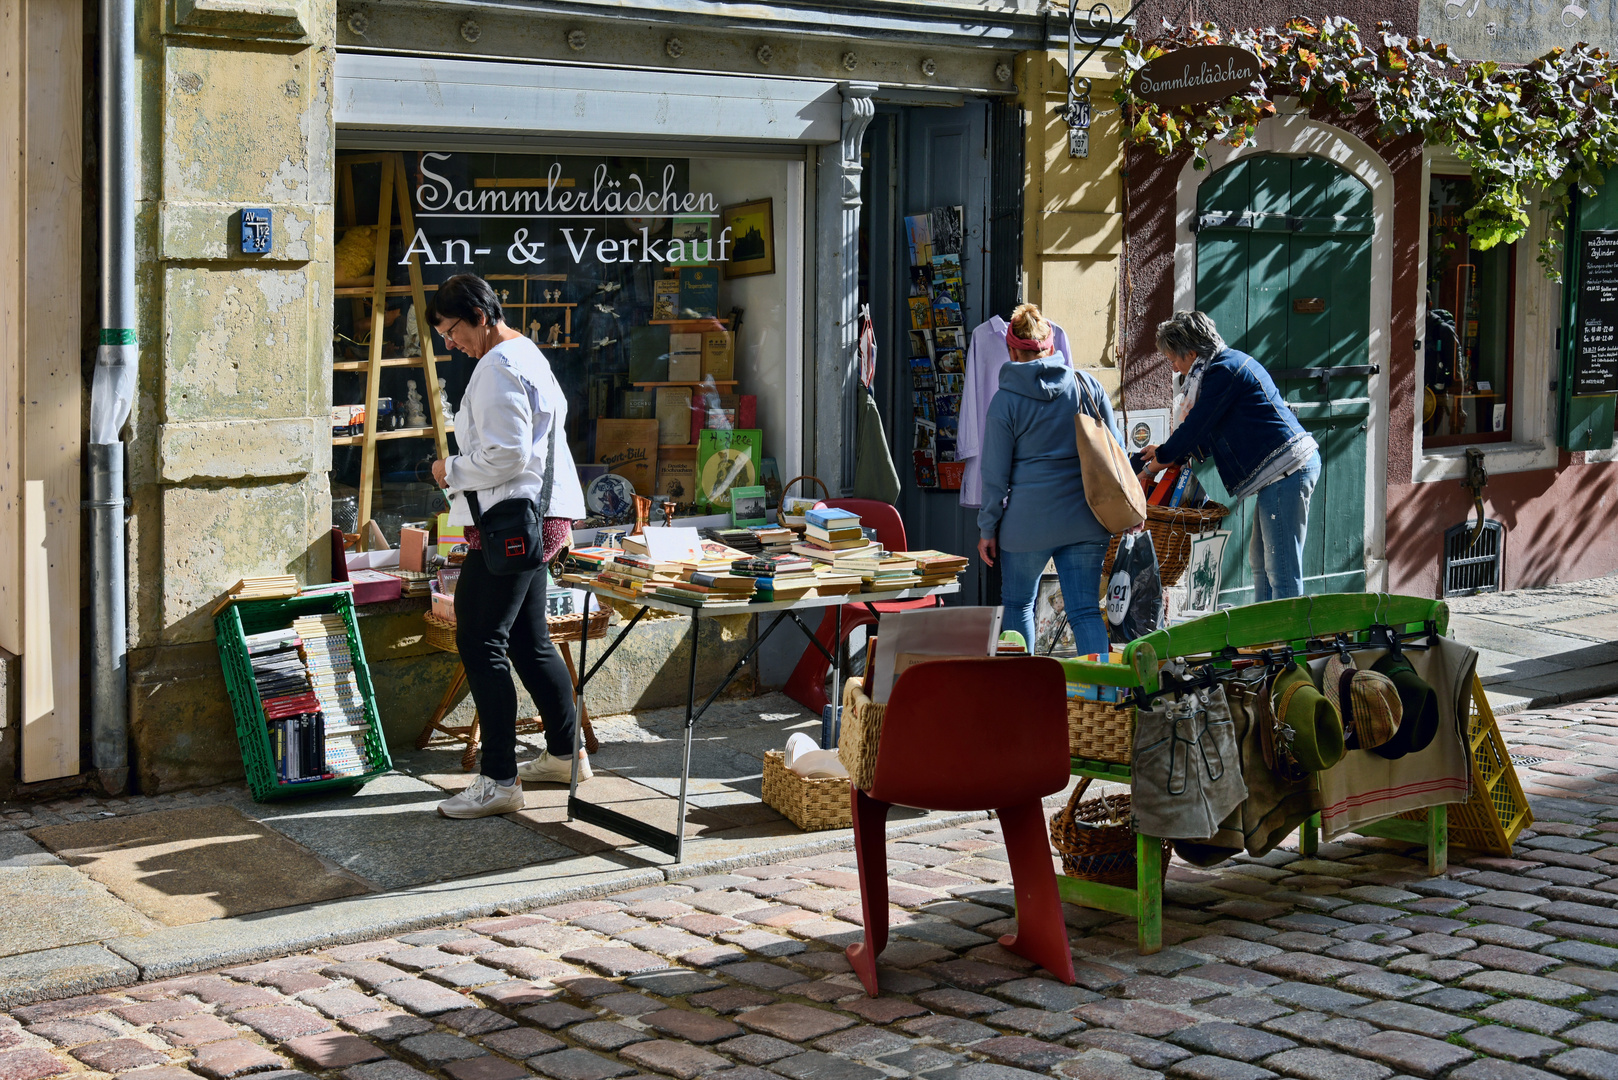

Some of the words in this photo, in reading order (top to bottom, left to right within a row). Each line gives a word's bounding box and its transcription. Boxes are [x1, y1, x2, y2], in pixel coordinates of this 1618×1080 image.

[1140, 56, 1252, 94] Sammlerlädchen
[415, 152, 719, 212] Sammlerlädchen
[245, 212, 255, 221] AV
[1428, 211, 1448, 227] Das
[1450, 210, 1462, 227] ist
[397, 227, 491, 265] An-
[506, 227, 546, 265] &
[559, 226, 733, 264] Verkauf
[1177, 475, 1188, 490] Spiele
